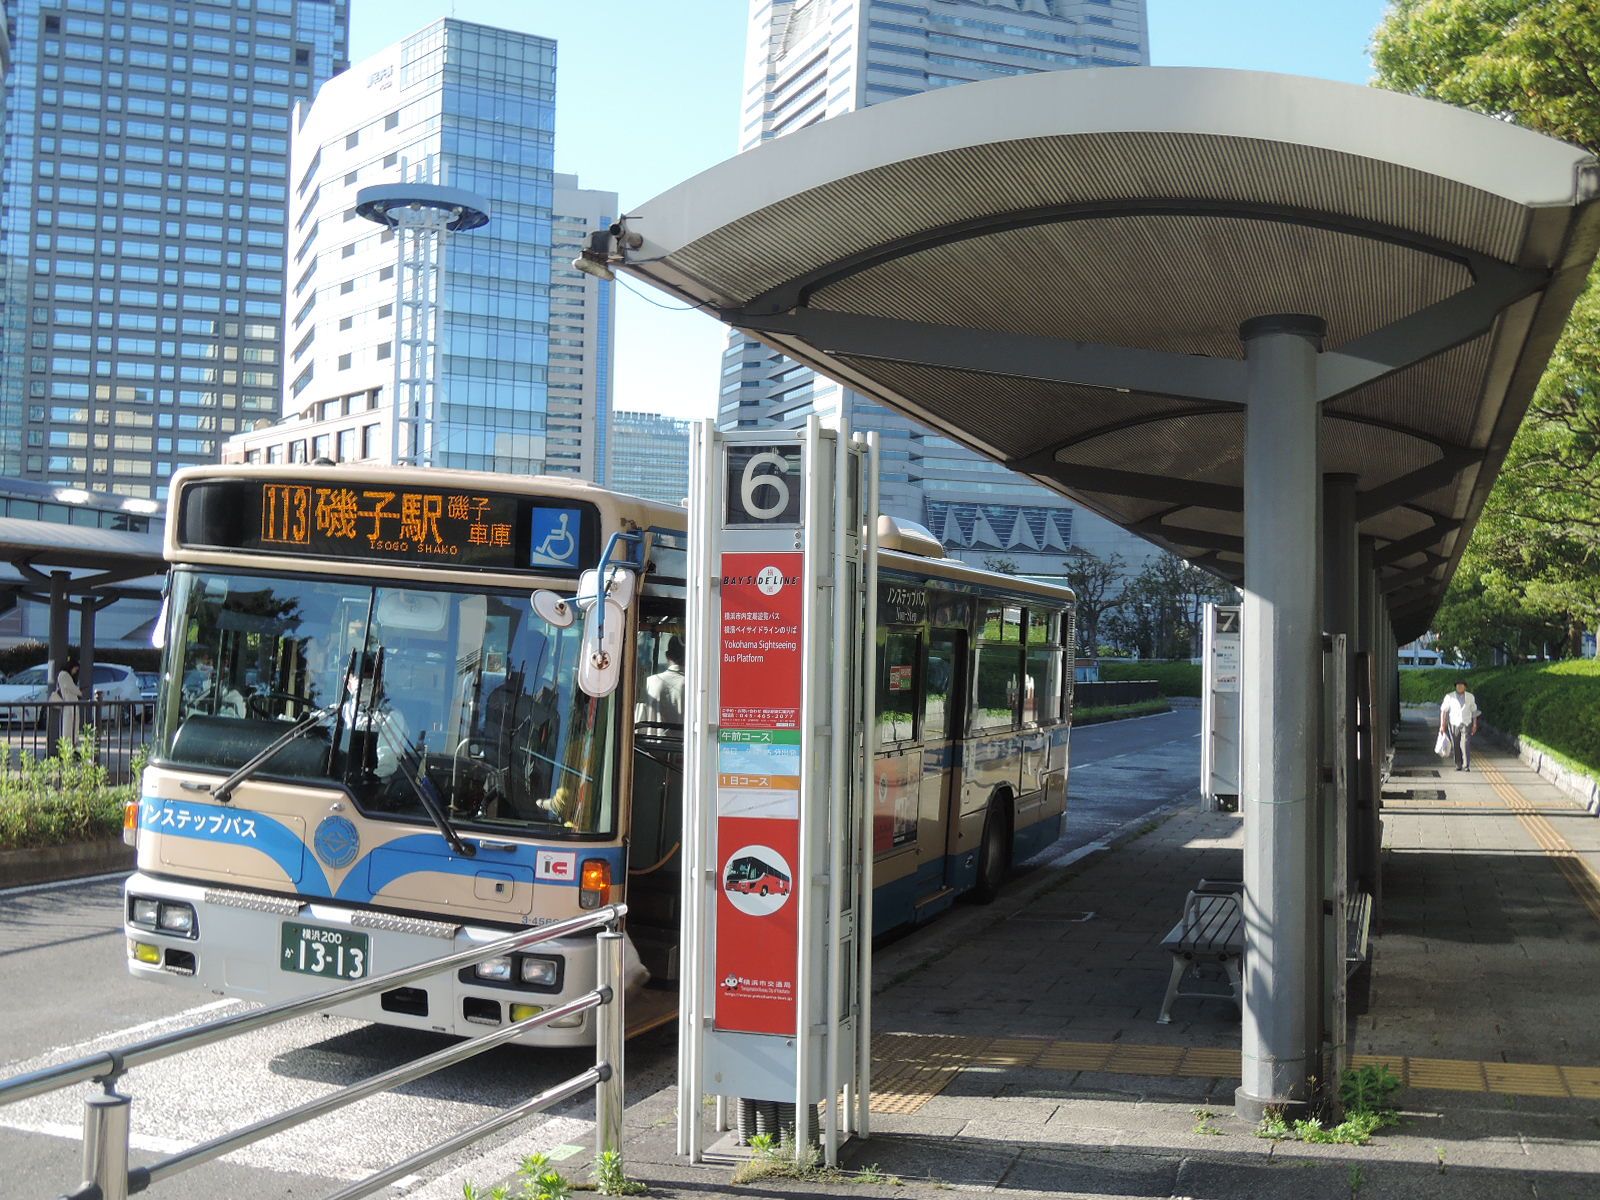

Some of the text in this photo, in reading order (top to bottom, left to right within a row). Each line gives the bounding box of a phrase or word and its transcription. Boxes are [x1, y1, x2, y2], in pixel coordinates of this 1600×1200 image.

[741, 452, 790, 520] 6
[267, 487, 491, 544] 113 磯子駅 磯子
[467, 522, 513, 548] 車庫
[369, 540, 459, 556] ISOGO SHAKO
[887, 587, 926, 607] ノンステップバス
[1220, 611, 1236, 632] 7
[724, 640, 797, 651] Yokohama Sightseeing
[724, 653, 764, 663] Bus Platform
[721, 731, 771, 742] 午前コース
[299, 939, 364, 978] 13-13
